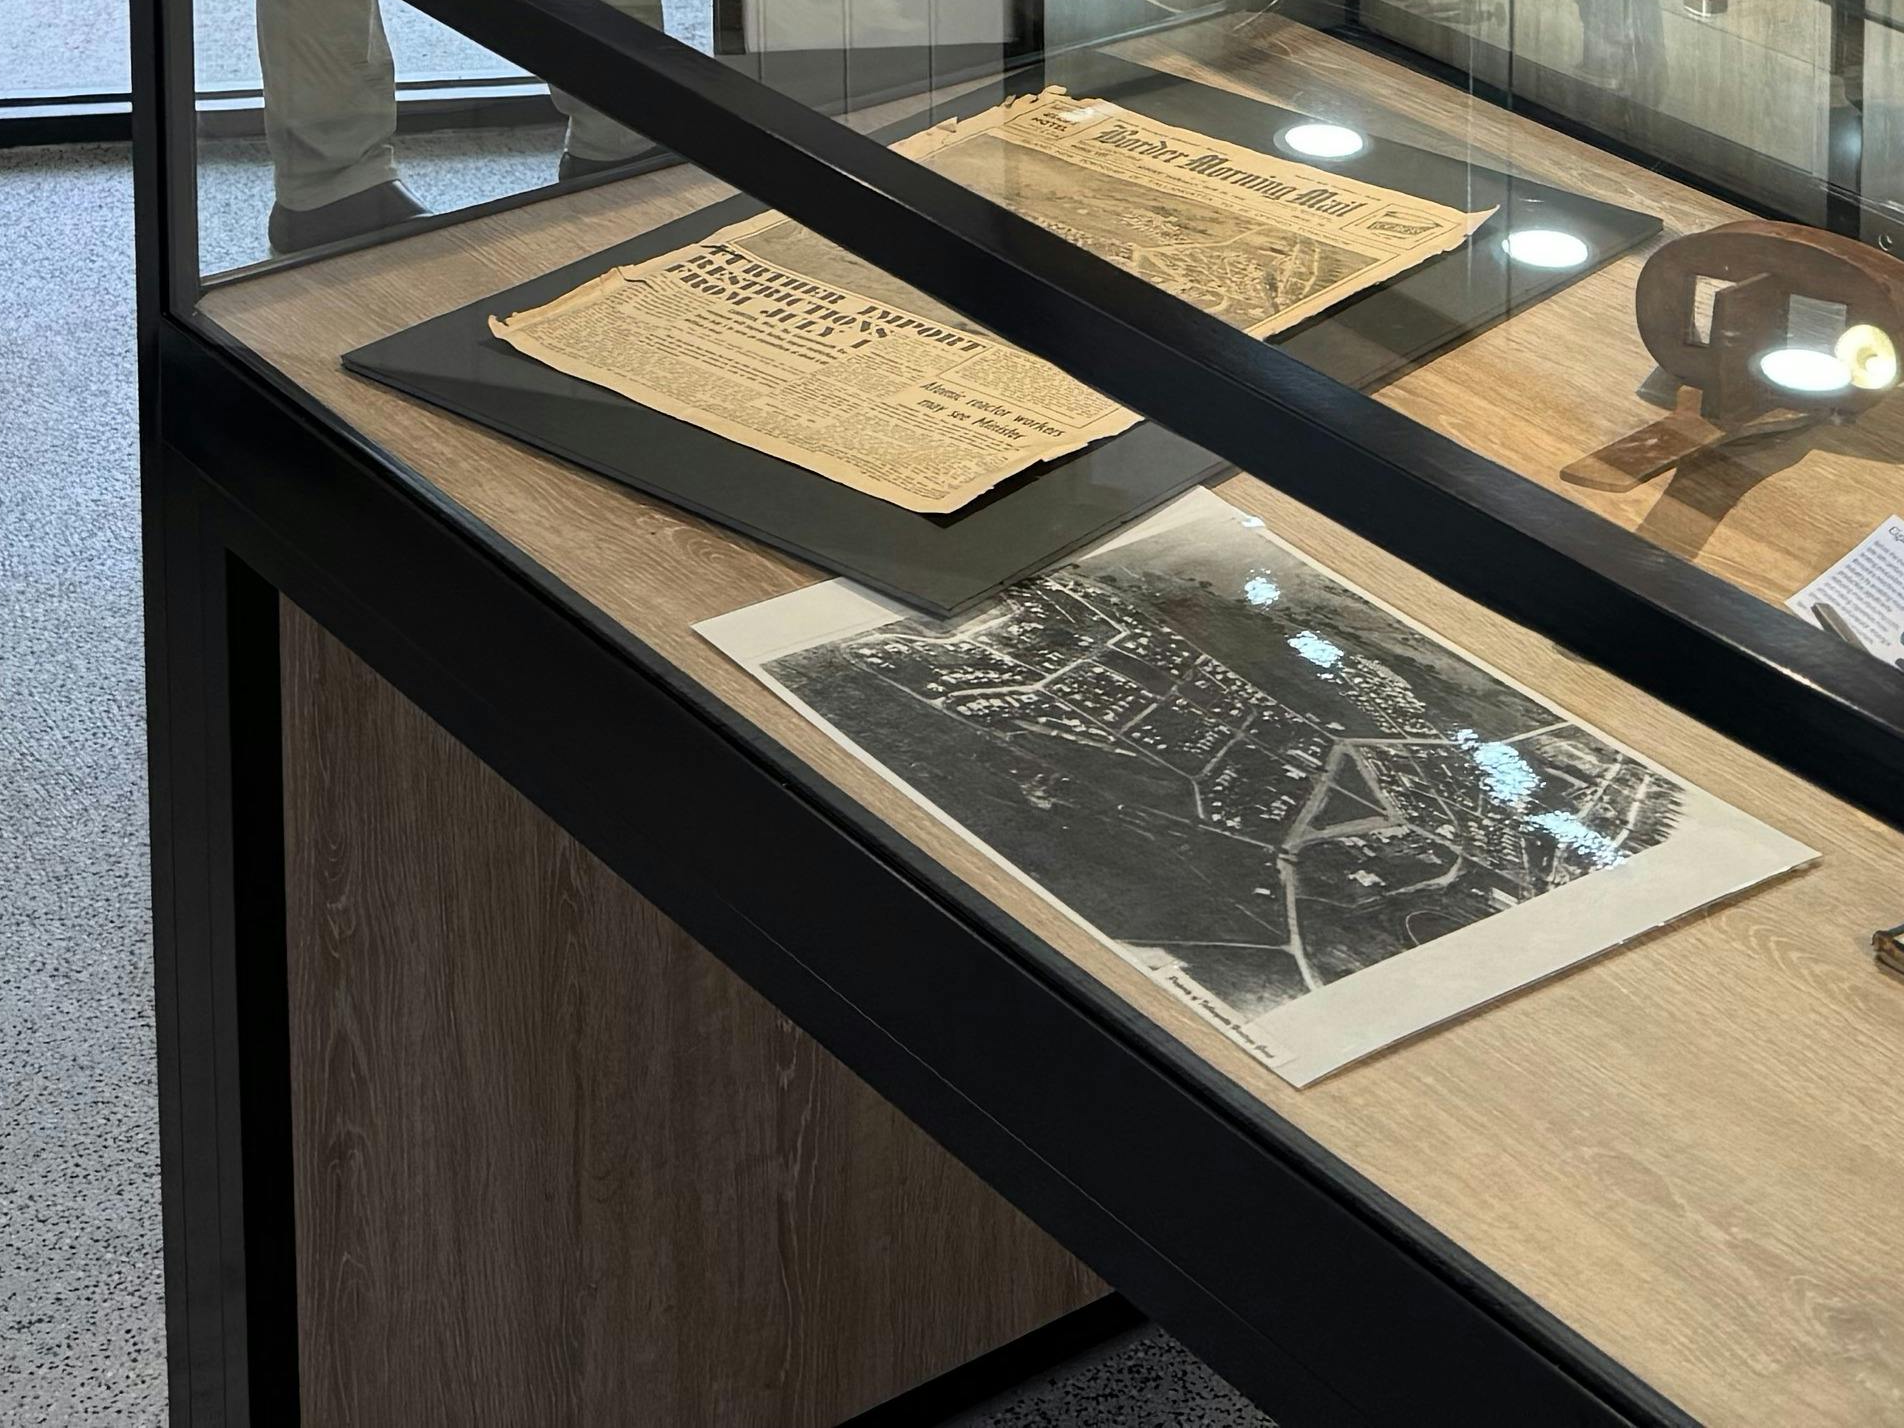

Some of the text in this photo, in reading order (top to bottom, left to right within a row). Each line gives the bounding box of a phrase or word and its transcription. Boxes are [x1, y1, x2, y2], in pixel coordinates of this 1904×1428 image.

[1097, 124, 1368, 218] Border Morning Mail
[665, 263, 752, 305] FROM
[686, 255, 894, 338] RESTRICTIONS
[857, 306, 986, 352] IMPORT
[917, 398, 949, 413] may
[947, 409, 971, 421] see
[966, 397, 1012, 418] reactor
[1013, 415, 1067, 438] workers
